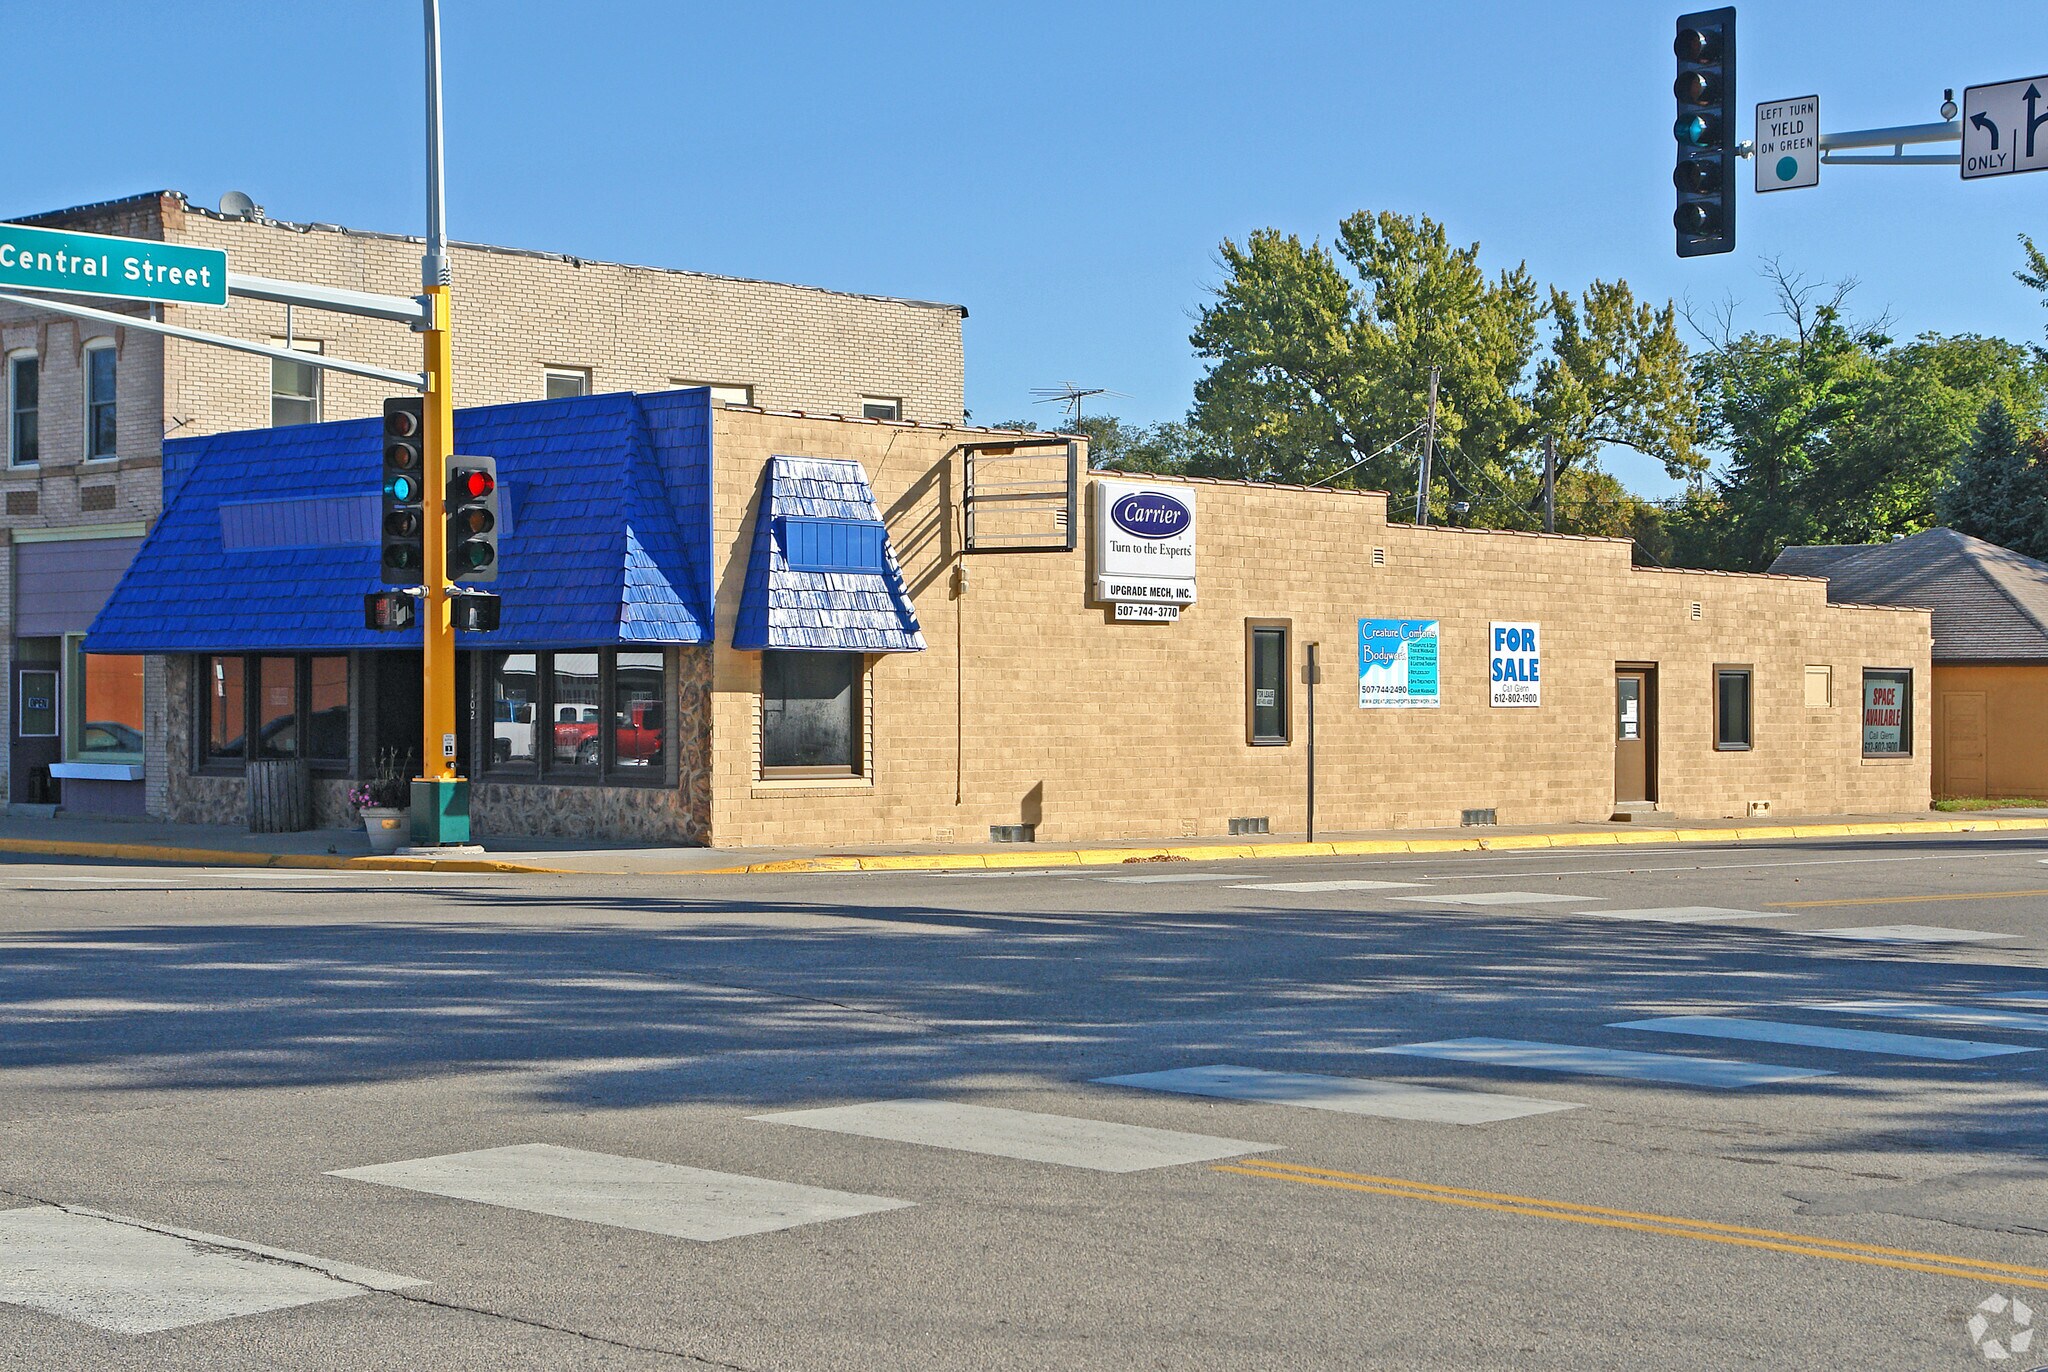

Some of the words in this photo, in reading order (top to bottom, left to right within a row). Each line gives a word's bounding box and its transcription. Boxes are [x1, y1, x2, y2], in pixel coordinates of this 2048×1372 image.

[1761, 107, 1783, 121] LEFT
[1789, 103, 1814, 116] TURN
[1770, 120, 1804, 137] YIELD
[1761, 142, 1774, 154] ON
[1780, 137, 1813, 151] GREEN
[1967, 153, 2007, 171] ONLY
[0, 243, 108, 277] Central
[123, 257, 211, 288] Street
[1124, 502, 1181, 524] Carrier
[1109, 540, 1131, 553] Turn
[1133, 544, 1142, 554] to
[1144, 542, 1158, 555] the
[1159, 543, 1192, 559] Experts
[1110, 584, 1147, 597] UPGRADE
[1149, 586, 1174, 599] MECH,
[1176, 588, 1192, 599] INC.
[1117, 605, 1178, 618] 507-744-3770
[1362, 621, 1399, 640] Creature
[1399, 622, 1436, 643] Comforts
[1494, 627, 1536, 652] FOR
[1491, 657, 1540, 682] SALE
[1873, 687, 1896, 706] SPACE
[1865, 708, 1900, 727] AVAILABLE
